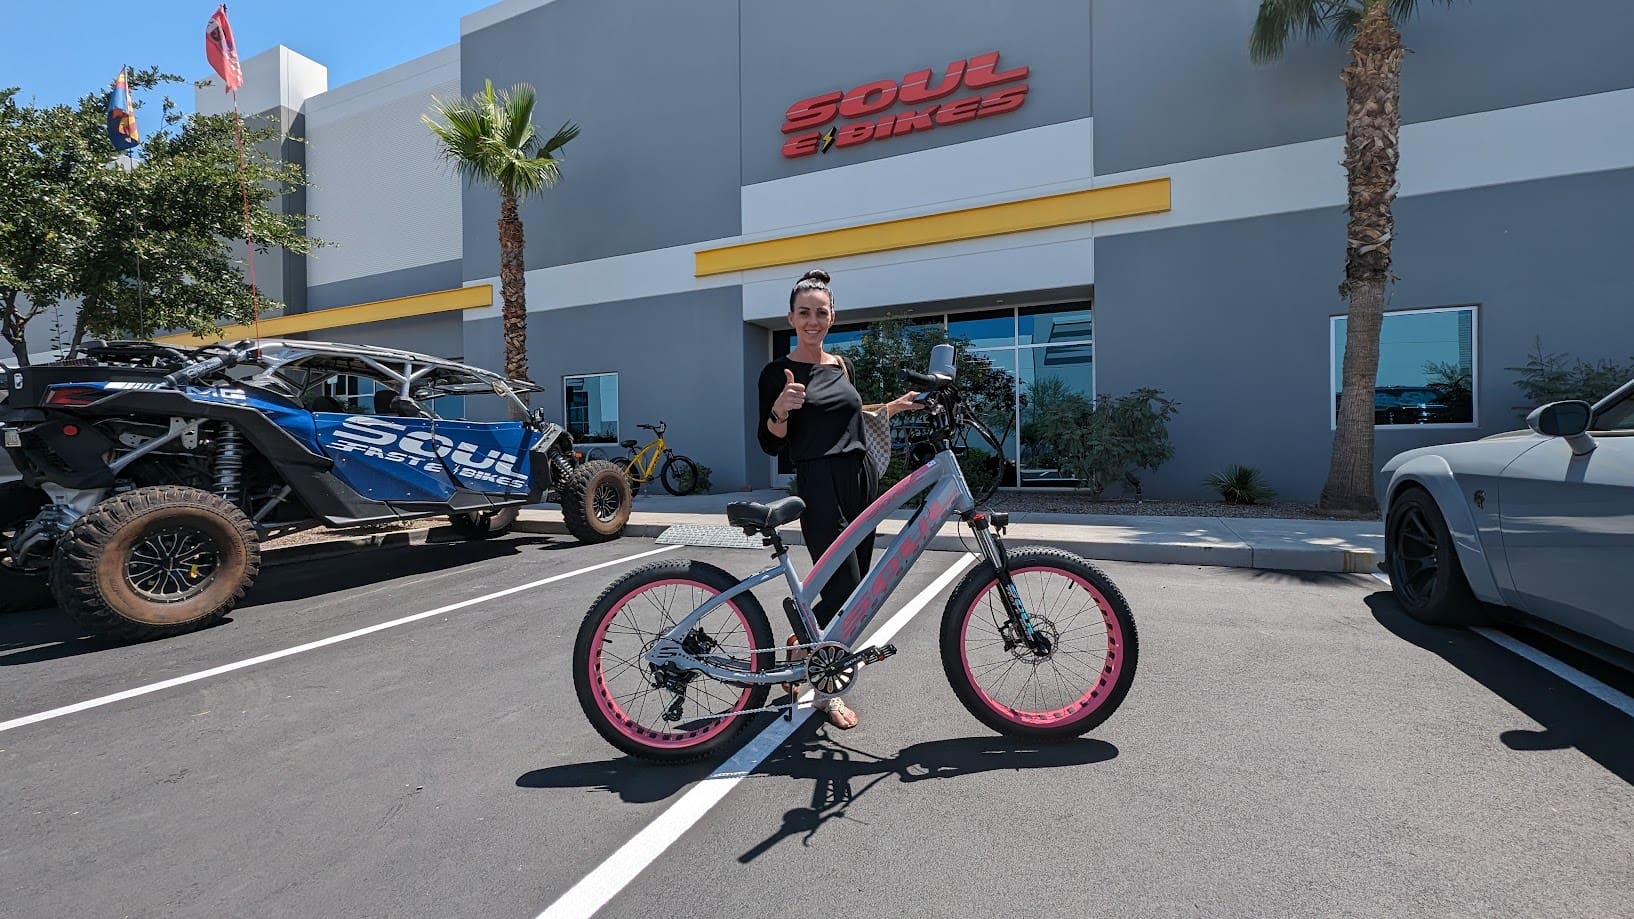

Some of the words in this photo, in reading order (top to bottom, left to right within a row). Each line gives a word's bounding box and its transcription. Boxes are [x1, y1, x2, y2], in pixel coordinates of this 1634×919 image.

[781, 51, 1029, 134] SOUL
[326, 439, 431, 465] FAST
[332, 416, 528, 481] SOUL
[841, 489, 958, 638] SOUL
